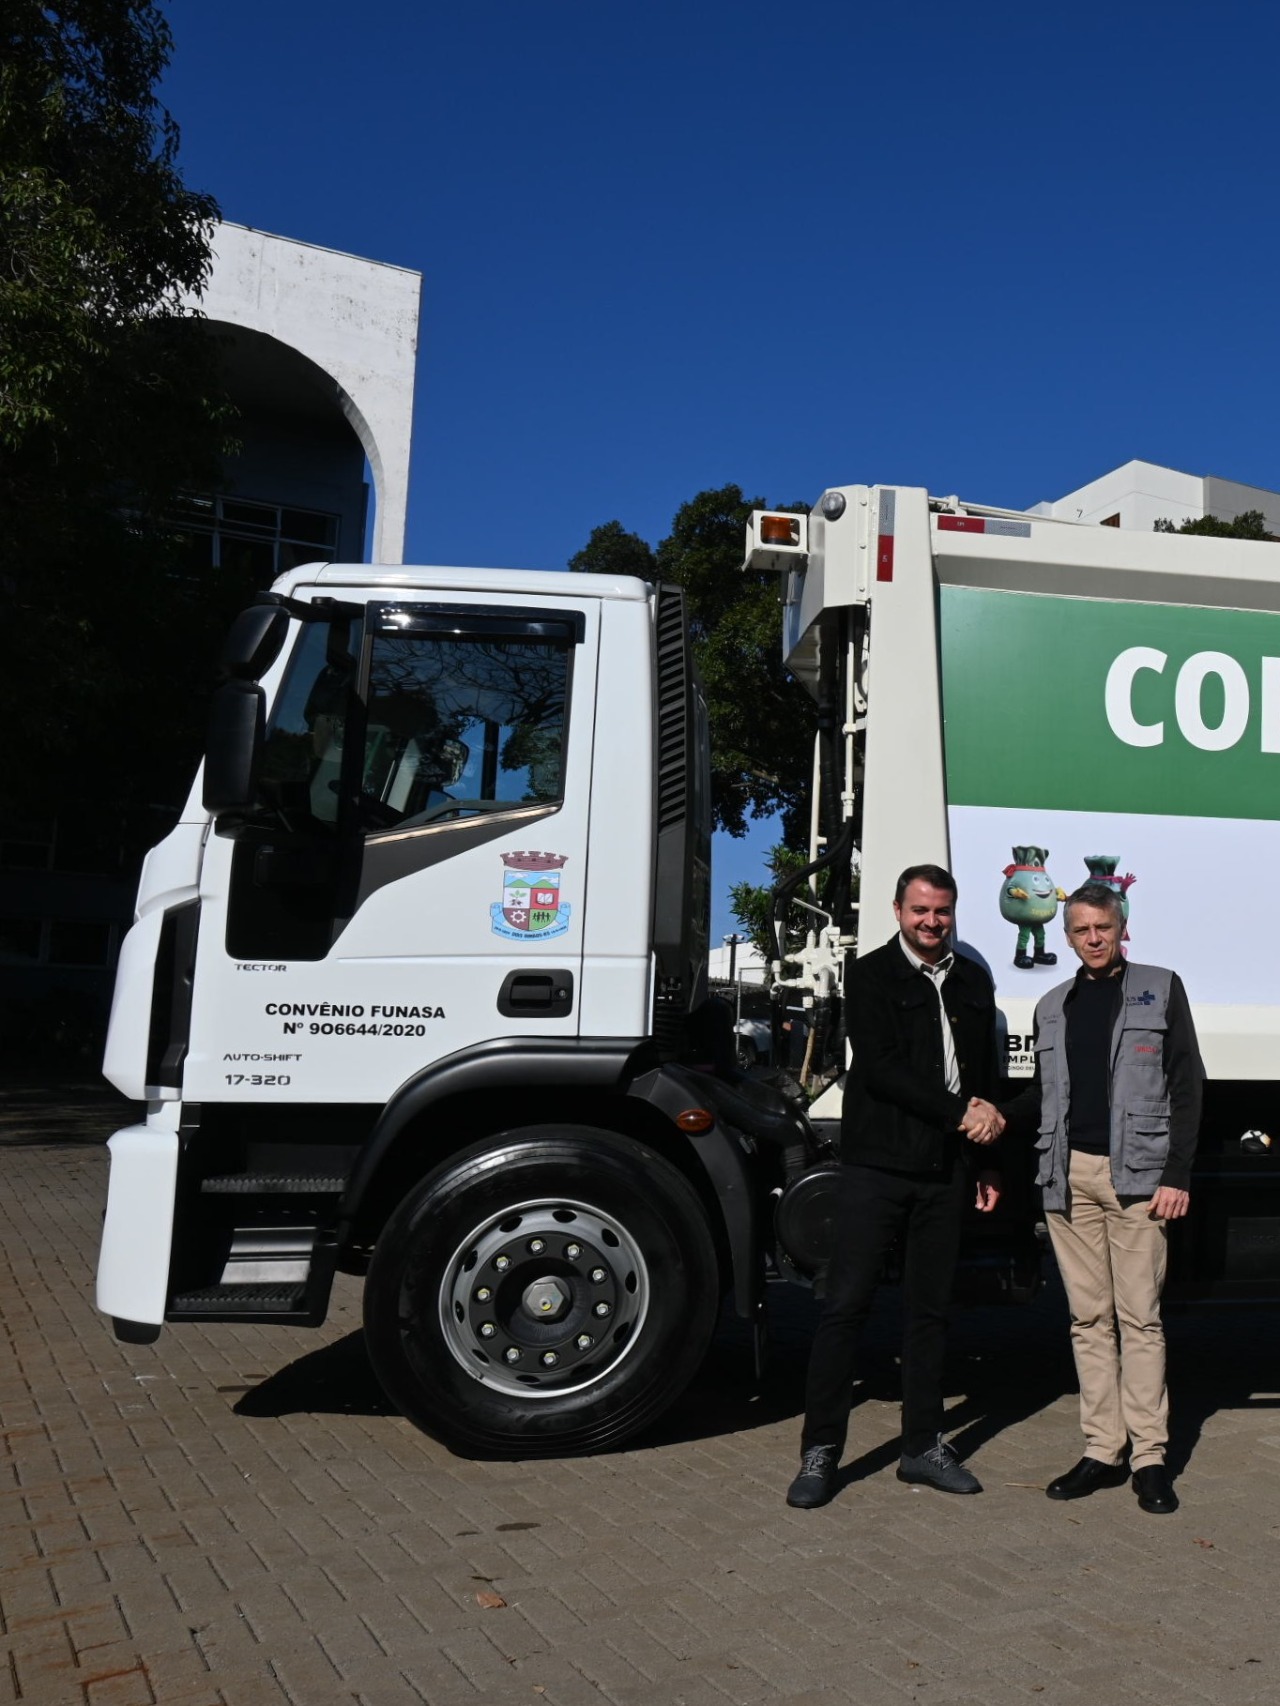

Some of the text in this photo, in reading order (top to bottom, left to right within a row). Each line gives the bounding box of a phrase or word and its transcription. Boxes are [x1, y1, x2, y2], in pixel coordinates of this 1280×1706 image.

[235, 963, 287, 972] TECTOR
[265, 1001, 446, 1019] CONVÊNIO FUNASA
[223, 1053, 303, 1062] AUTO-SHIFT
[225, 1074, 291, 1086] 17-320
